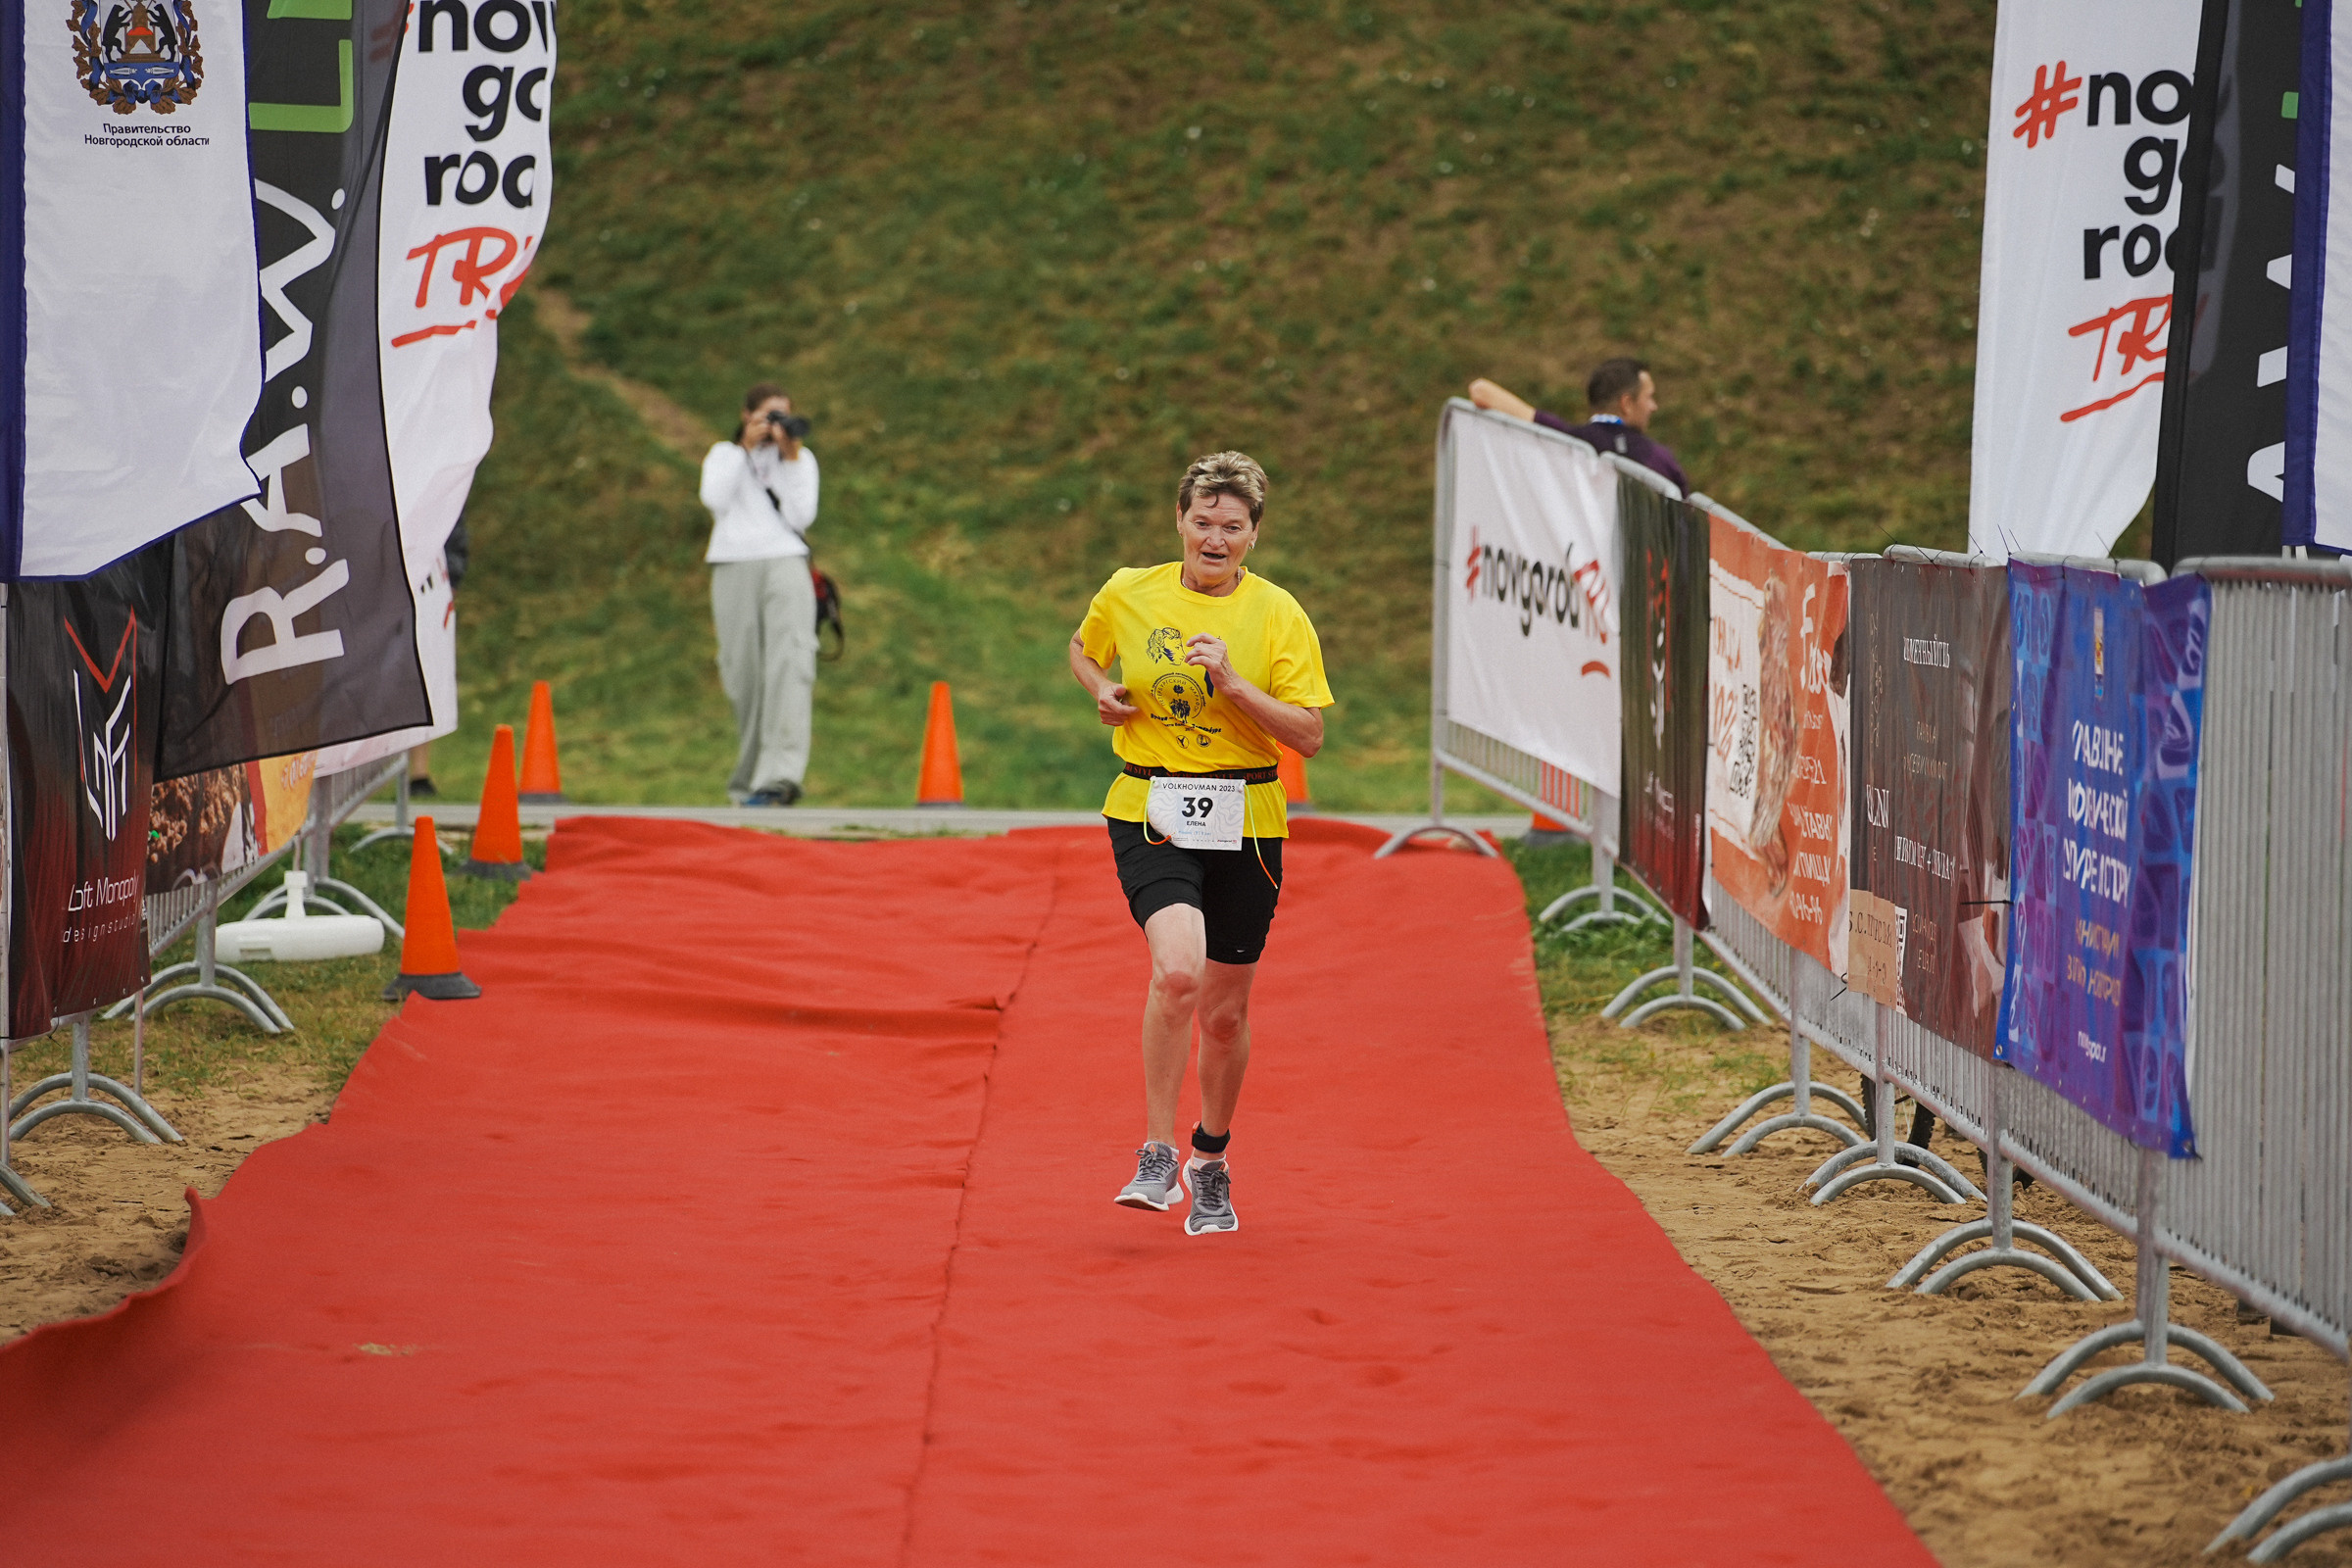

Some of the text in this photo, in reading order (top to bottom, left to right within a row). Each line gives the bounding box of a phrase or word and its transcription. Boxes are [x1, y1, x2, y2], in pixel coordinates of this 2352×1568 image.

[2013, 61, 2194, 148] #no
[103, 122, 191, 135] Правительство
[84, 134, 210, 148] Новгородской области
[1162, 783, 1236, 793] VOLKHOVMAN 2023
[1181, 797, 1214, 818] 39
